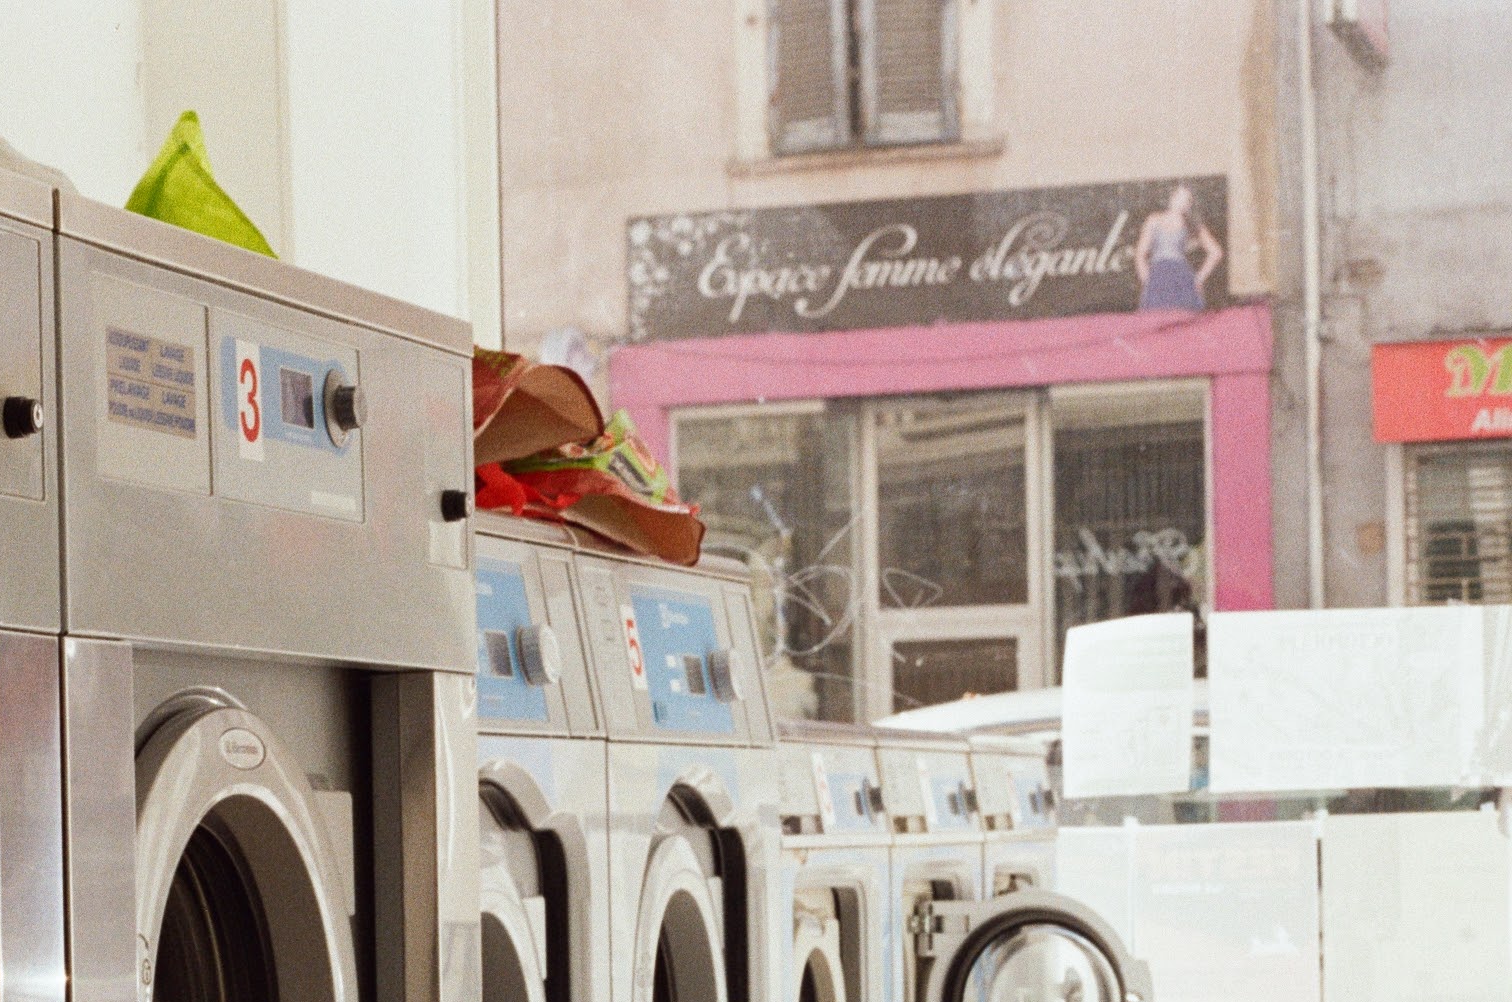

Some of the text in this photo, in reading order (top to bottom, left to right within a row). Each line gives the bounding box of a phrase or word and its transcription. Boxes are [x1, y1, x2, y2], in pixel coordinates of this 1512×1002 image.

[793, 222, 963, 319] femme
[239, 357, 261, 443] 3
[626, 619, 642, 676] 5
